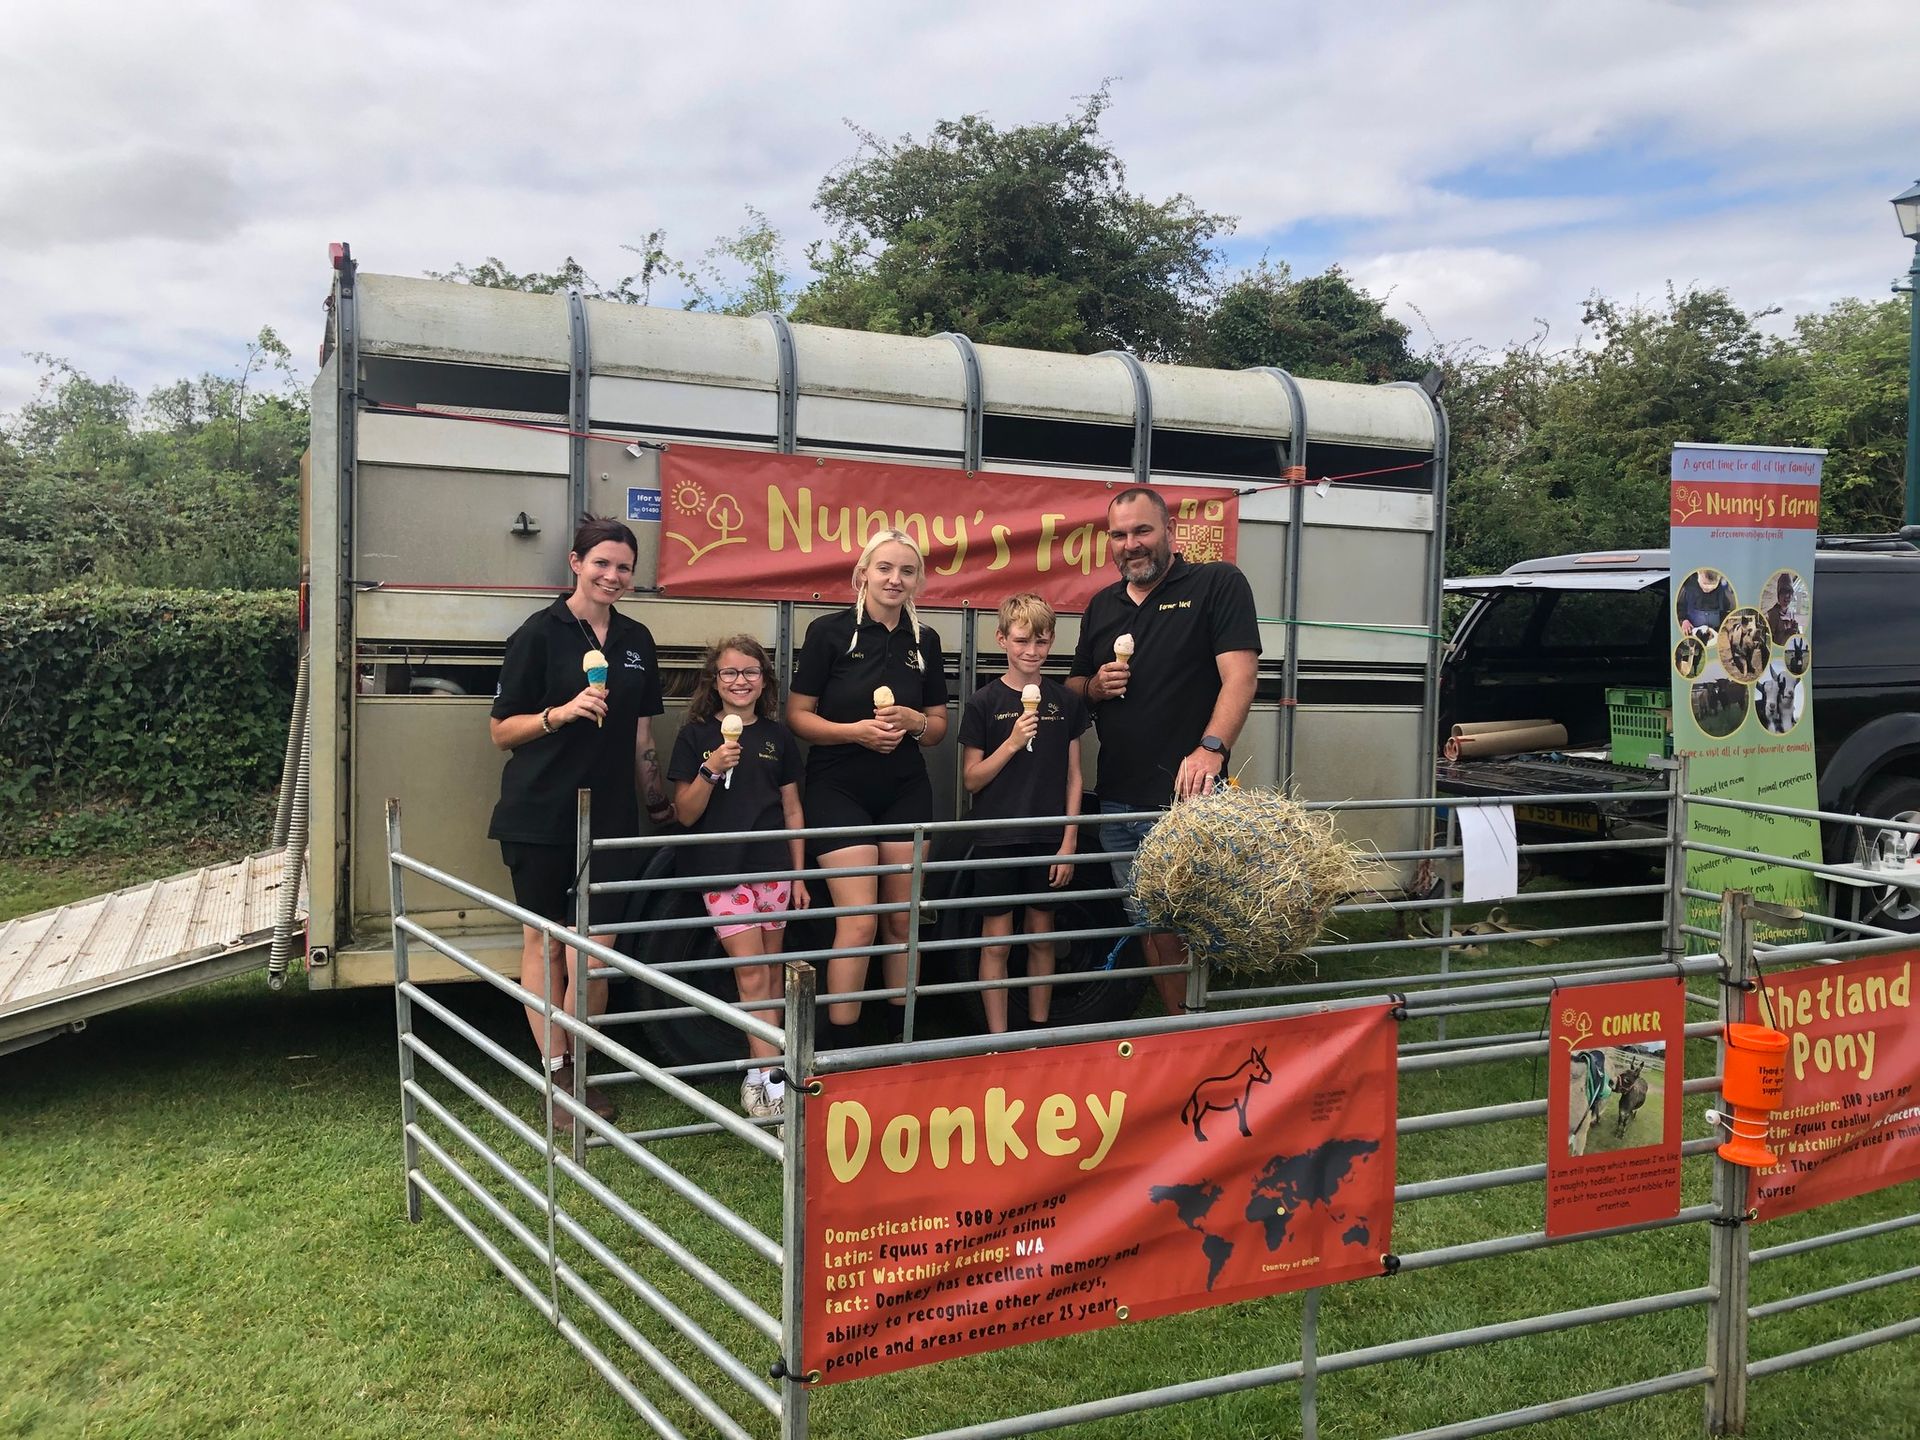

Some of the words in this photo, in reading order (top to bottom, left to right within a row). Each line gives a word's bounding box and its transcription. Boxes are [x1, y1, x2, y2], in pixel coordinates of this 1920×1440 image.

[1683, 458, 1689, 470] A
[1693, 458, 1715, 472] great
[1718, 459, 1734, 472] time
[1737, 459, 1748, 470] for
[1752, 459, 1761, 471] all
[1764, 461, 1773, 472] of
[1775, 460, 1785, 473] the
[1788, 461, 1815, 476] family!
[1706, 492, 1776, 522] Nunny's
[1781, 494, 1818, 517] Farm
[767, 484, 1012, 577] Nunny's
[1037, 513, 1112, 575] Far
[1722, 746, 1730, 757] all
[1779, 771, 1813, 789] experiences
[1694, 820, 1731, 837] Sponsorships
[1759, 963, 1911, 1030] Shetland
[1602, 1010, 1662, 1037] CONKER
[1792, 1031, 1876, 1081] Pony
[1767, 1100, 1841, 1121] mestication:
[1867, 1089, 1894, 1107] years
[826, 1087, 1127, 1184] Donkey
[1768, 1125, 1791, 1139] tin:
[1794, 1120, 1826, 1135] Equus
[1788, 1136, 1842, 1154] Watchlist
[1560, 1180, 1588, 1192] naughty
[1626, 1173, 1639, 1181] can
[1640, 1167, 1676, 1179] sometimes
[1570, 1166, 1584, 1176] still
[1586, 1164, 1606, 1176] young
[1607, 1161, 1627, 1170] which
[1667, 1153, 1679, 1161] like
[1573, 1194, 1584, 1203] bit
[1586, 1192, 1599, 1200] too
[1599, 1186, 1627, 1199] excited
[1628, 1185, 1641, 1194] and
[1664, 1179, 1676, 1188] for
[1757, 1184, 1797, 1199] horses
[825, 1215, 950, 1245] Domestication:
[956, 1208, 993, 1228] 5000
[999, 1203, 1037, 1225] years
[1042, 1193, 1066, 1209] ago
[825, 1250, 873, 1269] Latin:
[880, 1243, 928, 1262] Equus
[935, 1227, 1007, 1255] africanus
[1012, 1216, 1056, 1235] asinus
[825, 1295, 870, 1314] Fact:
[876, 1286, 932, 1309] Donkey
[936, 1276, 960, 1292] has
[966, 1262, 1044, 1287] excellent
[1050, 1254, 1110, 1277] memory
[1115, 1243, 1140, 1262] and
[826, 1271, 866, 1293] RBST
[872, 1260, 951, 1285] Watchlist
[955, 1245, 1010, 1269] Rating:
[1015, 1236, 1045, 1257] N/A
[826, 1321, 879, 1343] ability
[885, 1314, 902, 1328] to
[907, 1299, 988, 1323] recognize
[995, 1292, 1041, 1312] other
[1046, 1275, 1107, 1301] donkeys,
[826, 1345, 879, 1373] people
[884, 1336, 914, 1356] and
[920, 1331, 963, 1350] areas
[968, 1322, 1006, 1340] even
[1012, 1310, 1054, 1331] after
[1059, 1303, 1074, 1321] 25
[1078, 1297, 1118, 1320] years
